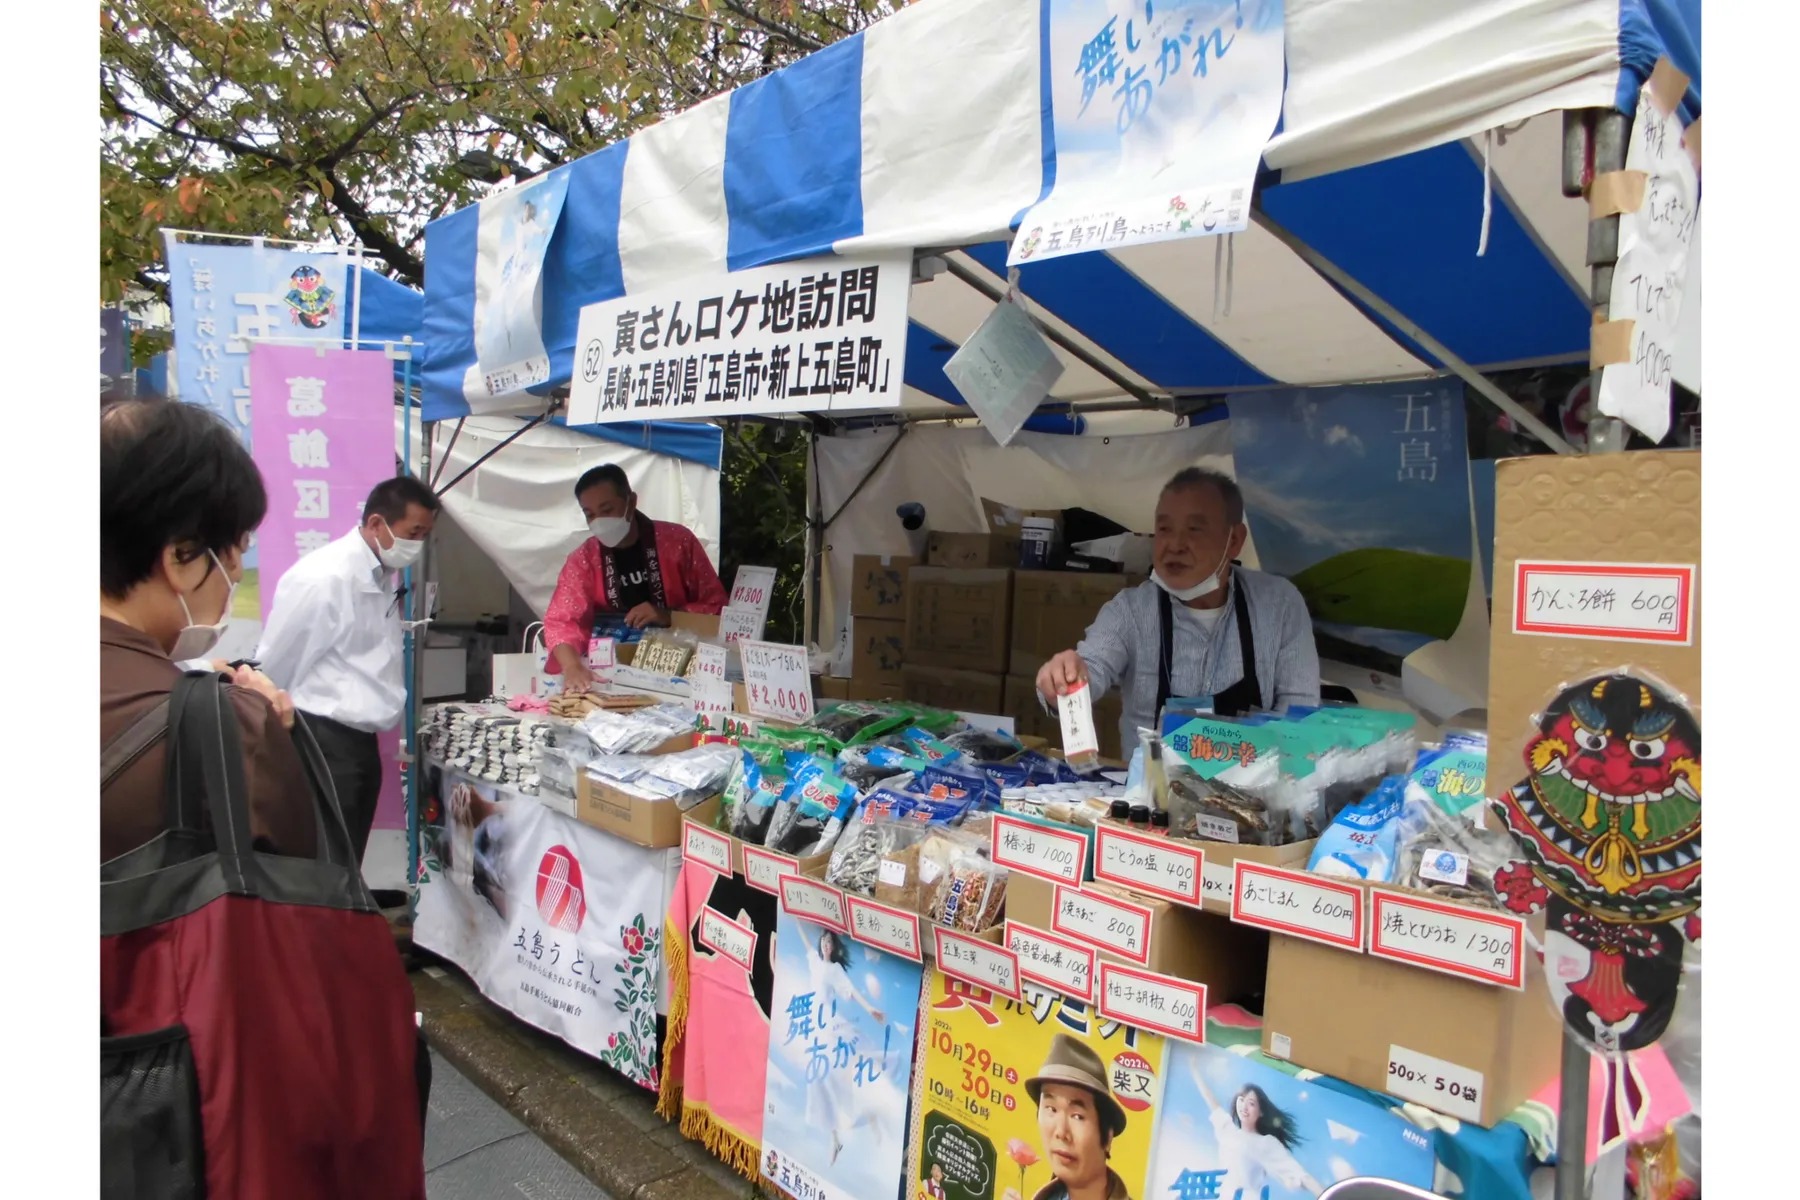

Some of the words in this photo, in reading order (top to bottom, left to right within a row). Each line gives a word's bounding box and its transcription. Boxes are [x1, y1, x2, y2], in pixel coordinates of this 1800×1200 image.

[1046, 215, 1172, 251] 五島列島へようこそ
[612, 264, 881, 358] 寅さんロケ地訪問
[584, 343, 602, 380] 52
[601, 335, 891, 412] 長崎・五島列島「五島市・新上五島町」
[1390, 390, 1438, 482] 五島
[1531, 586, 1617, 612] かんころ餅
[1631, 590, 1677, 611] 600
[1657, 611, 1673, 625] 円
[750, 683, 807, 714] ¥2,000
[1202, 725, 1243, 740] 西の島から
[1190, 732, 1257, 768] 海の幸
[803, 784, 840, 812] ひじき
[1003, 829, 1036, 855] 椿油
[1042, 845, 1074, 865] 1000
[1061, 865, 1073, 877] 円
[1106, 844, 1159, 873] ごとうの塩
[748, 858, 773, 881] ひじき
[1166, 861, 1193, 880] 400
[1177, 880, 1188, 891] 円
[1243, 879, 1300, 909] あごじまん
[1312, 896, 1353, 921] 600円
[820, 896, 838, 913] 700
[855, 908, 884, 933] 魚粉
[890, 924, 911, 941] 300
[1061, 899, 1098, 923] 焼きあご
[1106, 917, 1136, 937] 800
[1126, 937, 1136, 949] 円
[513, 926, 601, 985] 五島うどん
[942, 941, 979, 966] 五島三菜
[1382, 911, 1458, 945] 焼とびうお
[1465, 932, 1513, 956] 1300
[1492, 957, 1506, 970] 円
[988, 961, 1011, 979] 400
[997, 977, 1007, 988] 円
[1065, 959, 1091, 977] 1000
[1072, 975, 1082, 987] 円
[1107, 979, 1166, 1012] 柚子胡椒
[1171, 999, 1196, 1019] 600
[1182, 1020, 1193, 1031] 円
[961, 1067, 1002, 1106] 30日
[1113, 1068, 1153, 1098] 柴又
[1402, 1127, 1428, 1148] NHK
